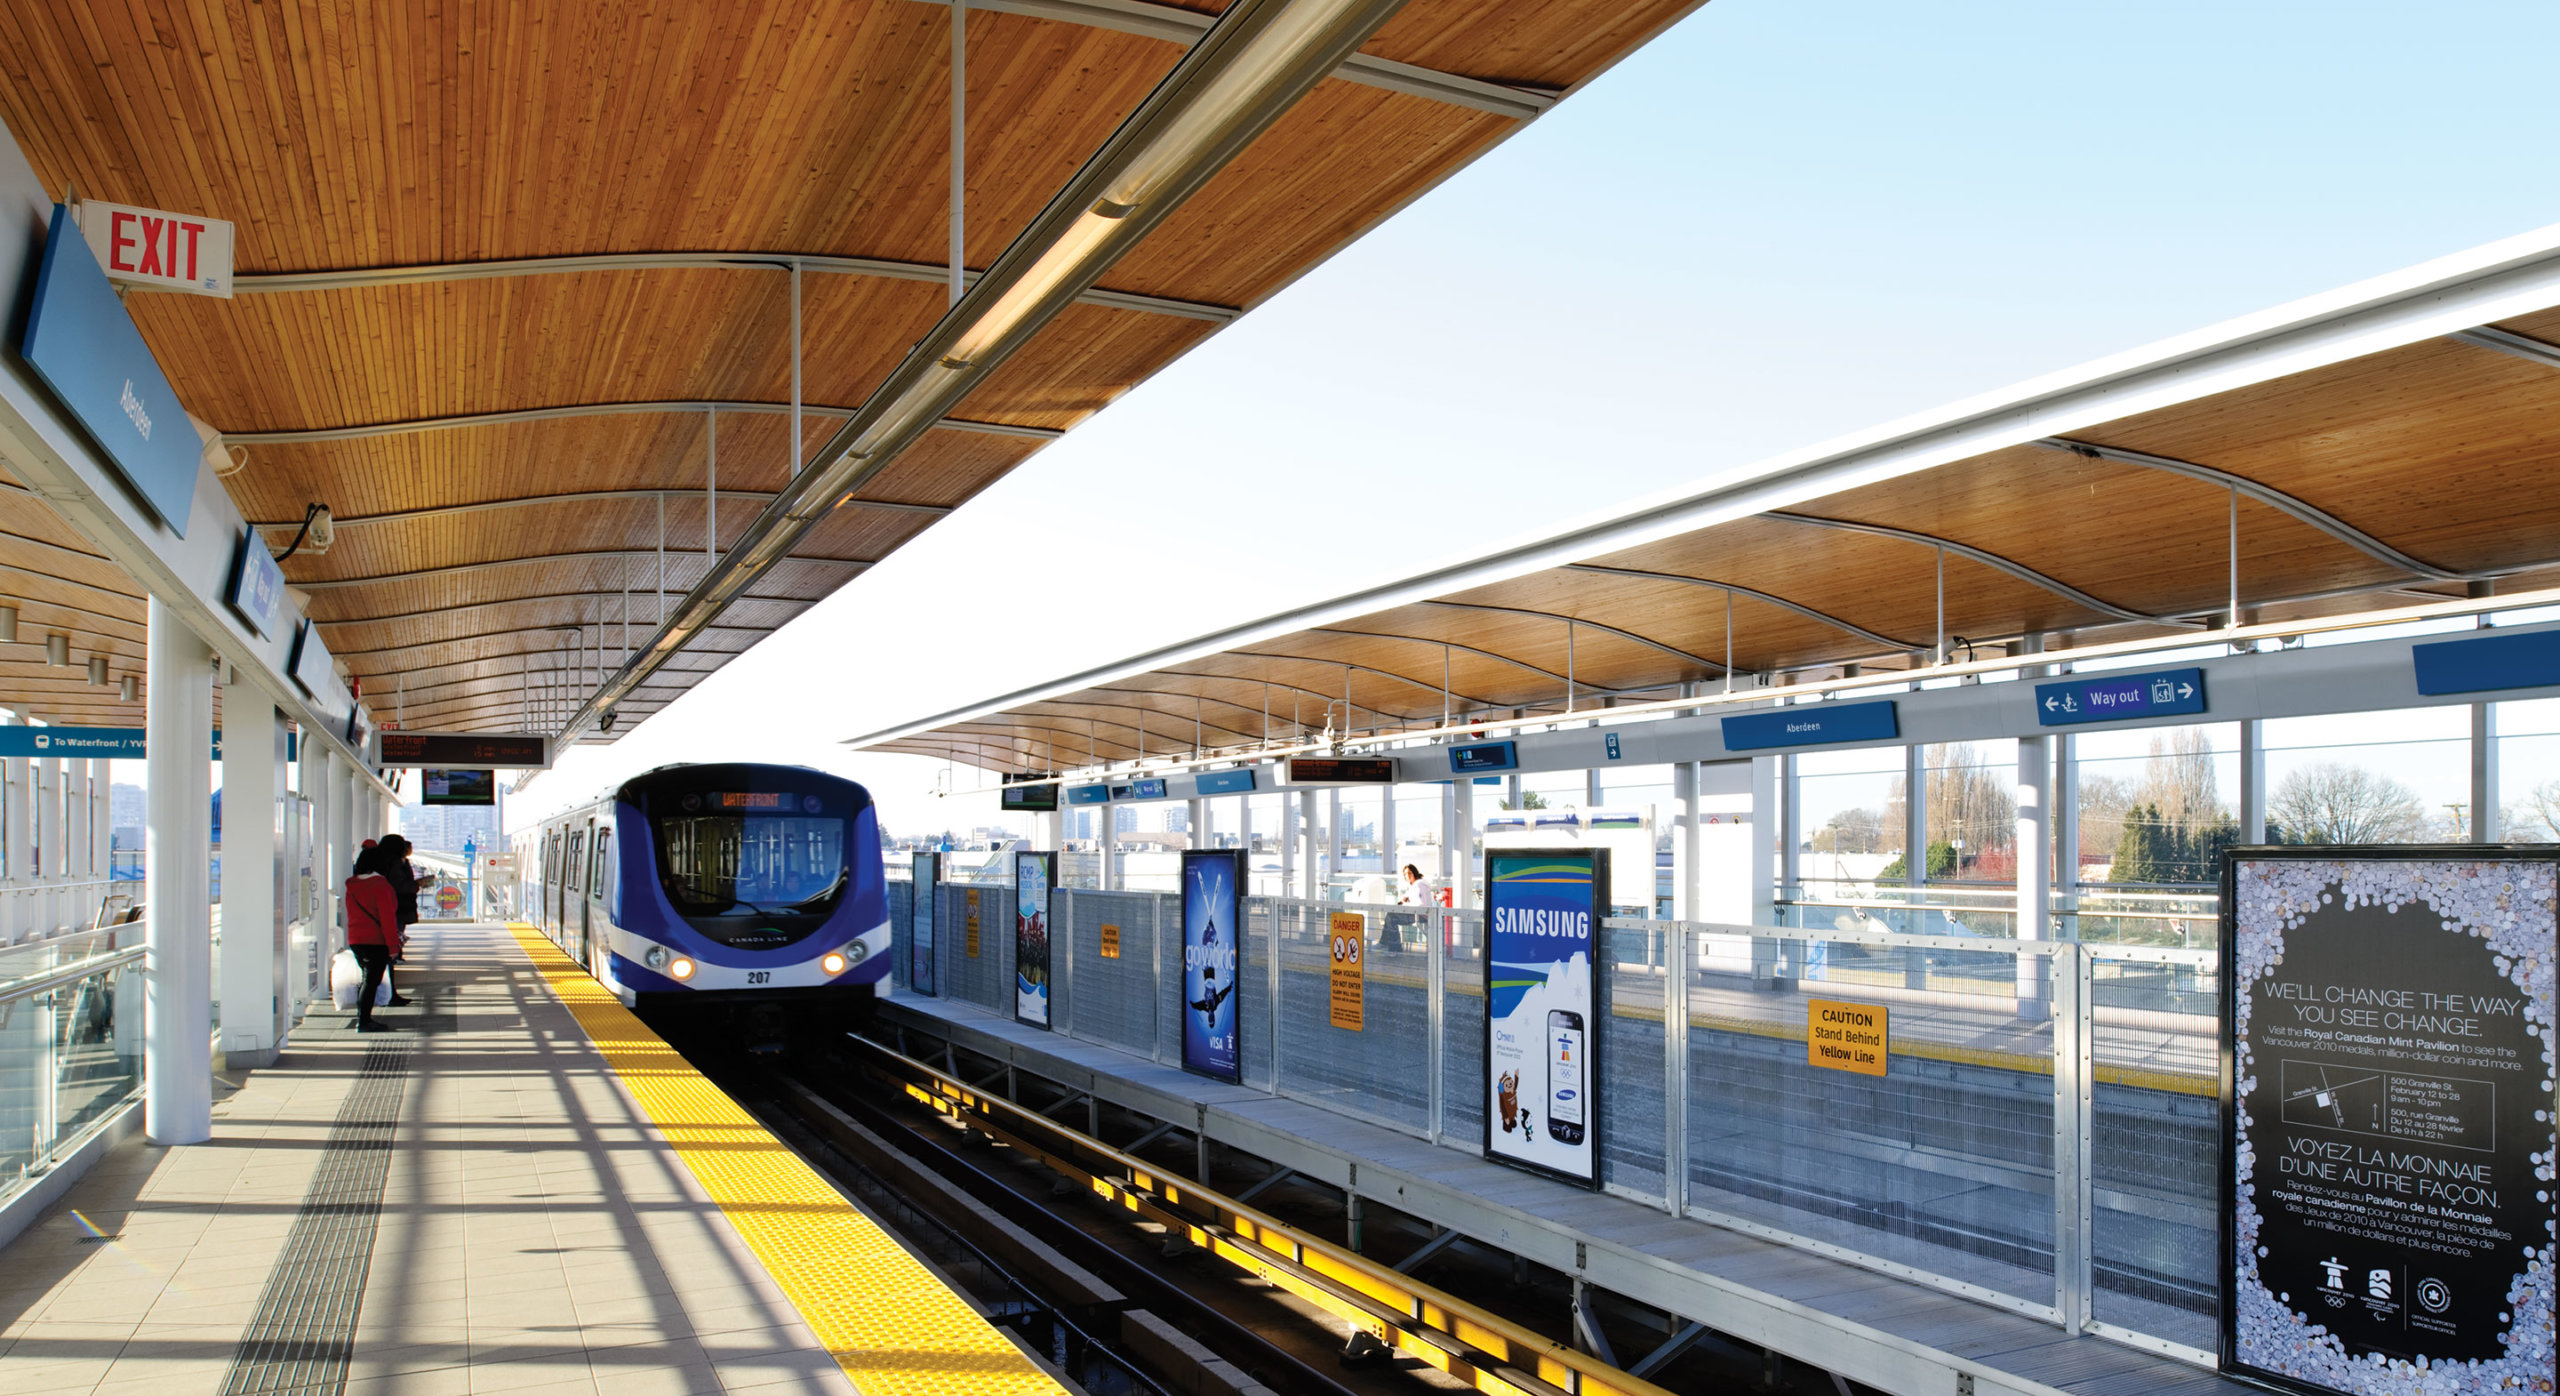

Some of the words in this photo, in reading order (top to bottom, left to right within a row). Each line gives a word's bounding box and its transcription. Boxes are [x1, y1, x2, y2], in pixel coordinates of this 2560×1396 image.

[110, 211, 205, 281] EXIT
[120, 378, 151, 441] Aberdeen
[2090, 692, 2116, 707] Way
[2119, 689, 2140, 703] out
[1786, 722, 1821, 733] Aberdeen
[55, 738, 66, 746] To
[66, 738, 119, 747] Waterfront
[722, 792, 779, 807] WATERFRONT
[1334, 920, 1360, 931] DANGER
[1495, 906, 1588, 939] SAMSUNG
[748, 971, 771, 984] 207
[1343, 970, 1360, 978] VOLTAGE
[1348, 982, 1361, 990] ENTER
[2264, 982, 2320, 1001] WE'LL
[2325, 986, 2414, 1008] CHANGE
[2420, 992, 2464, 1012] THE
[2470, 996, 2520, 1016] WAY
[1822, 1009, 1873, 1027] CAUTION
[2293, 1004, 2335, 1024] YOU
[2340, 1008, 2379, 1028] SEE
[2384, 1012, 2483, 1037] CHANGE.
[1209, 1036, 1224, 1051] VISA
[1815, 1026, 1842, 1041] Stand
[1845, 1030, 1880, 1046] Behind
[2268, 1025, 2286, 1035] Visit
[2287, 1027, 2303, 1037] the
[2304, 1028, 2333, 1041] Royal
[2335, 1031, 2385, 1045] Canadian
[2389, 1036, 2413, 1048] Mint
[2416, 1039, 2460, 1052] Pavilion
[2461, 1044, 2473, 1054] to
[2474, 1047, 2496, 1055] see
[2497, 1046, 2517, 1058] the
[1819, 1044, 1851, 1060] Yellow
[1855, 1049, 1875, 1064] Line
[2262, 1035, 2311, 1049] Vancouver
[2313, 1041, 2337, 1052] 2010
[2338, 1044, 2376, 1057] medals,
[2378, 1047, 2441, 1063] million-dollar
[2442, 1053, 2466, 1065] coin
[2467, 1057, 2489, 1068] and
[2490, 1061, 2524, 1071] more.
[2390, 1077, 2407, 1086] 500
[2408, 1079, 2442, 1090] Granville
[2390, 1086, 2426, 1097] February
[2428, 1090, 2437, 1098] 12
[2438, 1091, 2447, 1099] to
[2449, 1093, 2460, 1101] 28
[2417, 1098, 2426, 1106] 10
[2391, 1108, 2409, 1118] 500,
[2425, 1112, 2460, 1124] Granville
[2391, 1117, 2402, 1125] Du
[2426, 1122, 2437, 1130] 28
[2438, 1123, 2464, 1133] février
[2390, 1126, 2402, 1134] De
[2403, 1127, 2409, 1135] 9
[2410, 1128, 2416, 1136] h
[2425, 1130, 2436, 1139] 22
[2437, 1131, 2443, 1140] h
[2288, 1136, 2352, 1162] VOYEZ
[2359, 1147, 2385, 1167] LA
[2390, 1151, 2492, 1184] MONNAIE
[2280, 1156, 2337, 1181] D'UNE
[2343, 1167, 2412, 1194] AUTRE
[2420, 1179, 2501, 1209] FAÇON.
[2287, 1179, 2350, 1199] Rendez-vous
[2351, 1193, 2364, 1202] au
[2365, 1193, 2407, 1209] Pavillon
[2409, 1202, 2425, 1213] de
[2427, 1204, 2438, 1215] la
[2441, 1207, 2493, 1225] Monnaie
[2272, 1189, 2303, 1202] royale
[2305, 1196, 2366, 1214] canadienne
[2367, 1206, 2391, 1218] pour
[2393, 1211, 2399, 1221] y
[2401, 1213, 2441, 1228] admirer
[2442, 1219, 2459, 1231] les
[2459, 1224, 2512, 1241] médailles
[2285, 1203, 2303, 1214] des
[2304, 1206, 2327, 1217] Jeux
[2328, 1210, 2342, 1220] de
[2343, 1213, 2368, 1226] 2010
[2369, 1218, 2376, 1228] à
[2378, 1220, 2435, 1239] Vancouver,
[2436, 1230, 2446, 1241] la
[2447, 1234, 2478, 1247] pièce
[2479, 1239, 2495, 1250] de
[2303, 1218, 2316, 1226] un
[2317, 1219, 2346, 1233] million
[2347, 1226, 2361, 1236] de
[2362, 1229, 2395, 1243] dollars
[2396, 1236, 2407, 1246] et
[2408, 1239, 2430, 1250] plus
[2431, 1243, 2473, 1258] encore.
